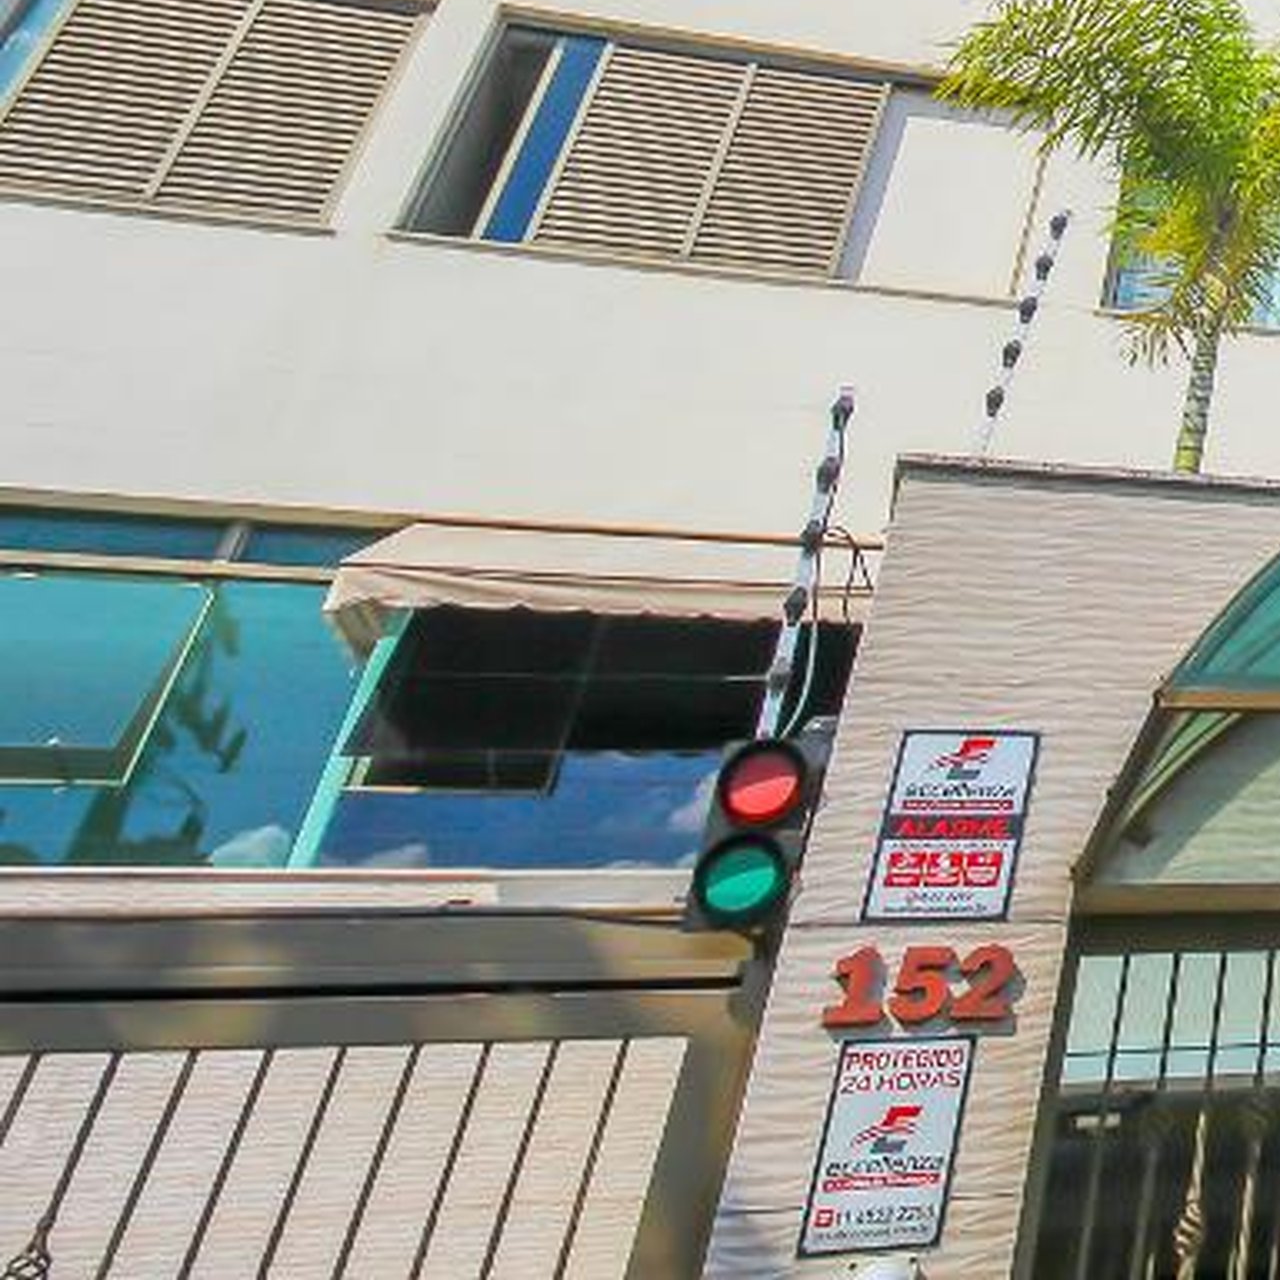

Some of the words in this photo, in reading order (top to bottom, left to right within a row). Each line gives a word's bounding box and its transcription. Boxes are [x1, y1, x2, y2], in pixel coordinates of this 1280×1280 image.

[822, 943, 1015, 1028] 152
[845, 1047, 964, 1070] PROTEGIDO
[840, 1074, 872, 1094] 24
[876, 1070, 961, 1092] HORAS
